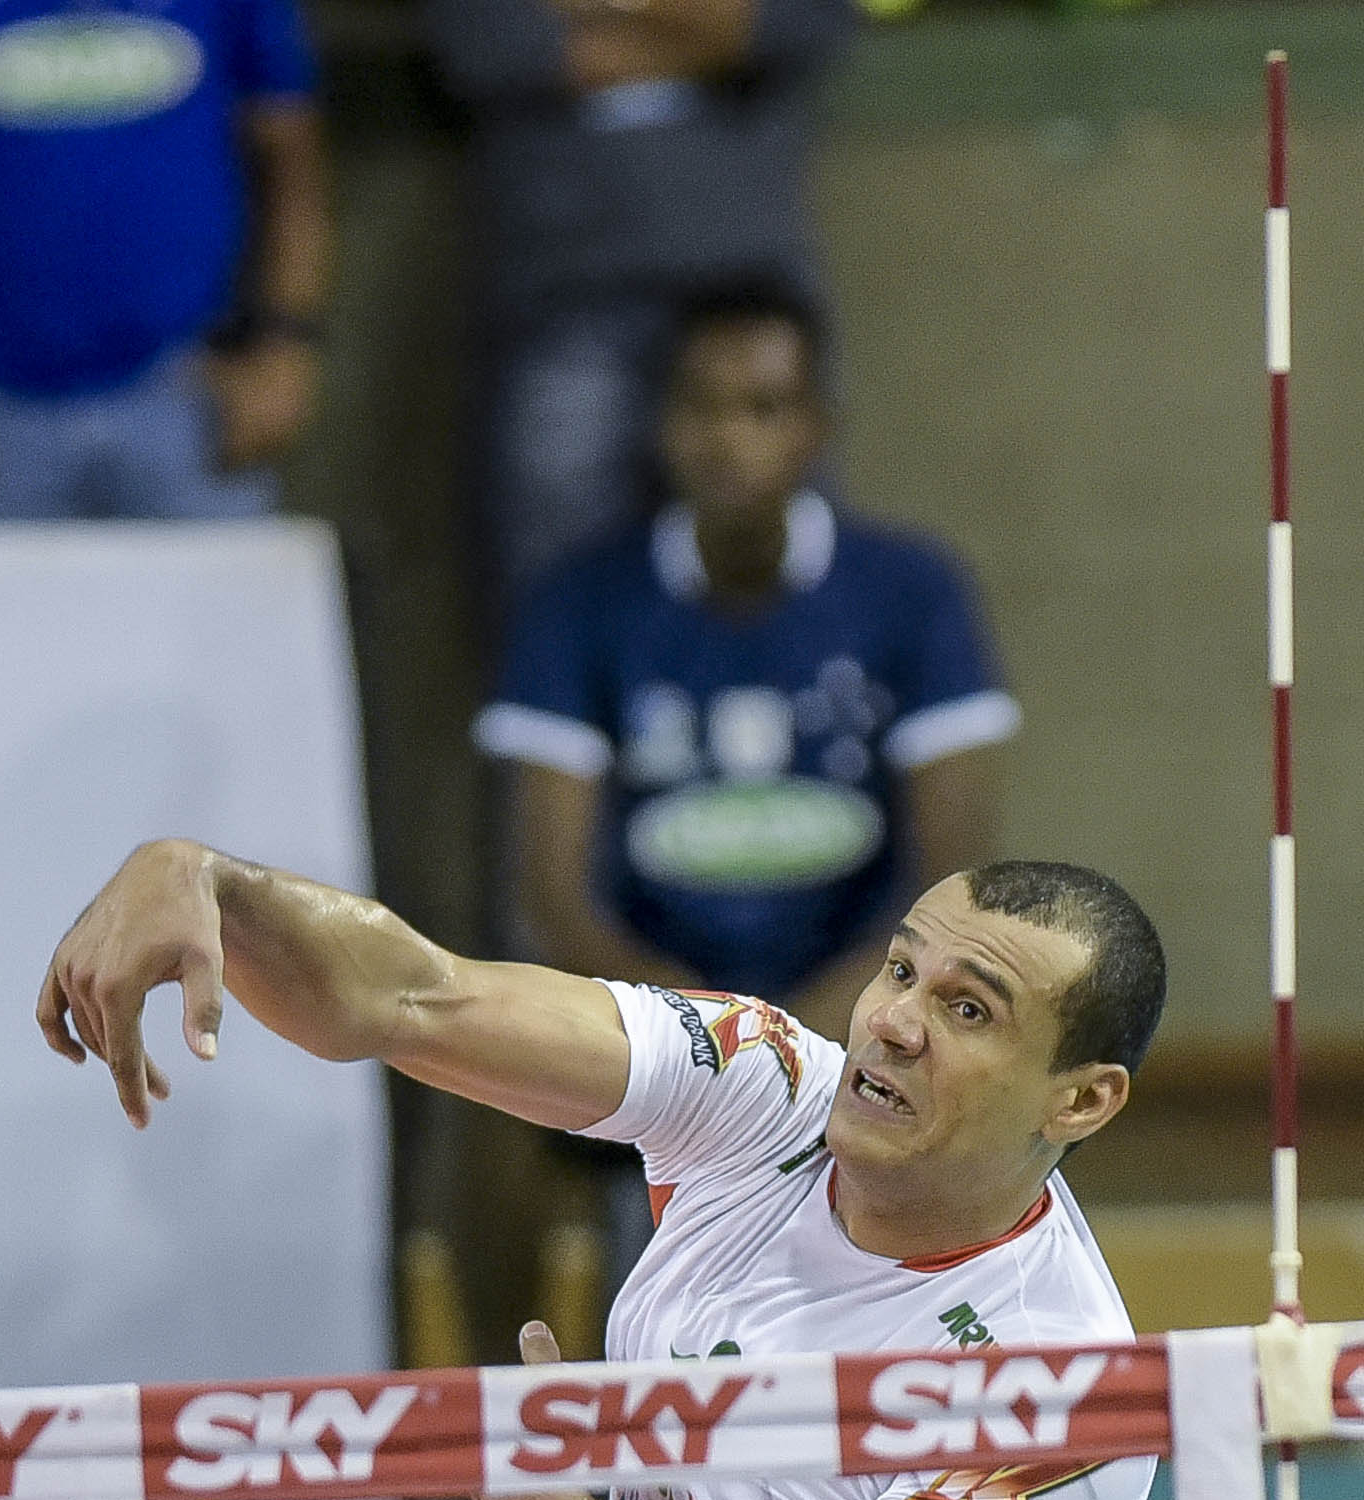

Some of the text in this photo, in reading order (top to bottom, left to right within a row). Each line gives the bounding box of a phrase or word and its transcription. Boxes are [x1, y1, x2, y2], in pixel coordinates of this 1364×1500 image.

[165, 1386, 419, 1492] SKY
[509, 1373, 754, 1475] SKY
[858, 1351, 1109, 1461] SKY
